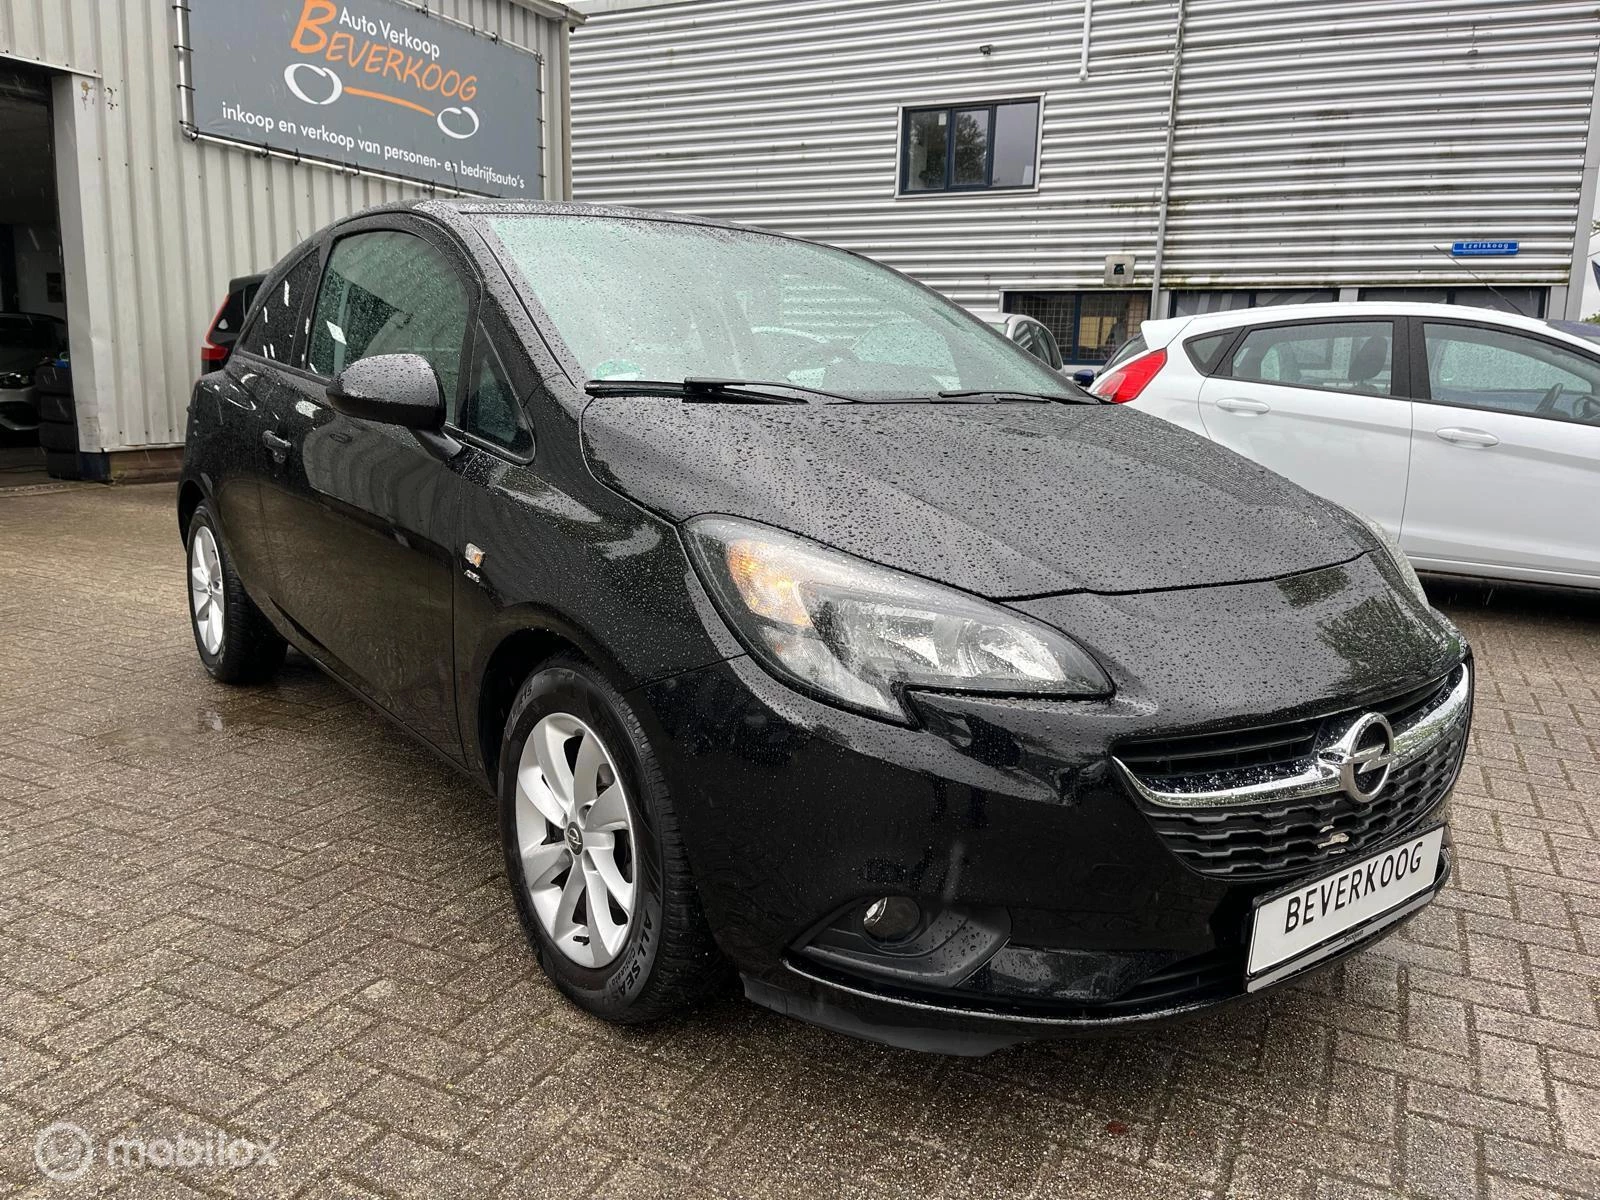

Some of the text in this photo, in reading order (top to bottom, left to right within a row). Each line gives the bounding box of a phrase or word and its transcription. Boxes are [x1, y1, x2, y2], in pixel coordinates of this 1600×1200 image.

[339, 7, 440, 61] Auto Verkoop
[222, 101, 274, 133] inkoop
[278, 120, 297, 134] en
[300, 124, 354, 151] verkoop
[357, 138, 381, 155] van
[384, 145, 441, 170] personen-
[444, 159, 458, 174] en
[1284, 841, 1423, 934] BEVERKOOG
[638, 909, 653, 957] ALL
